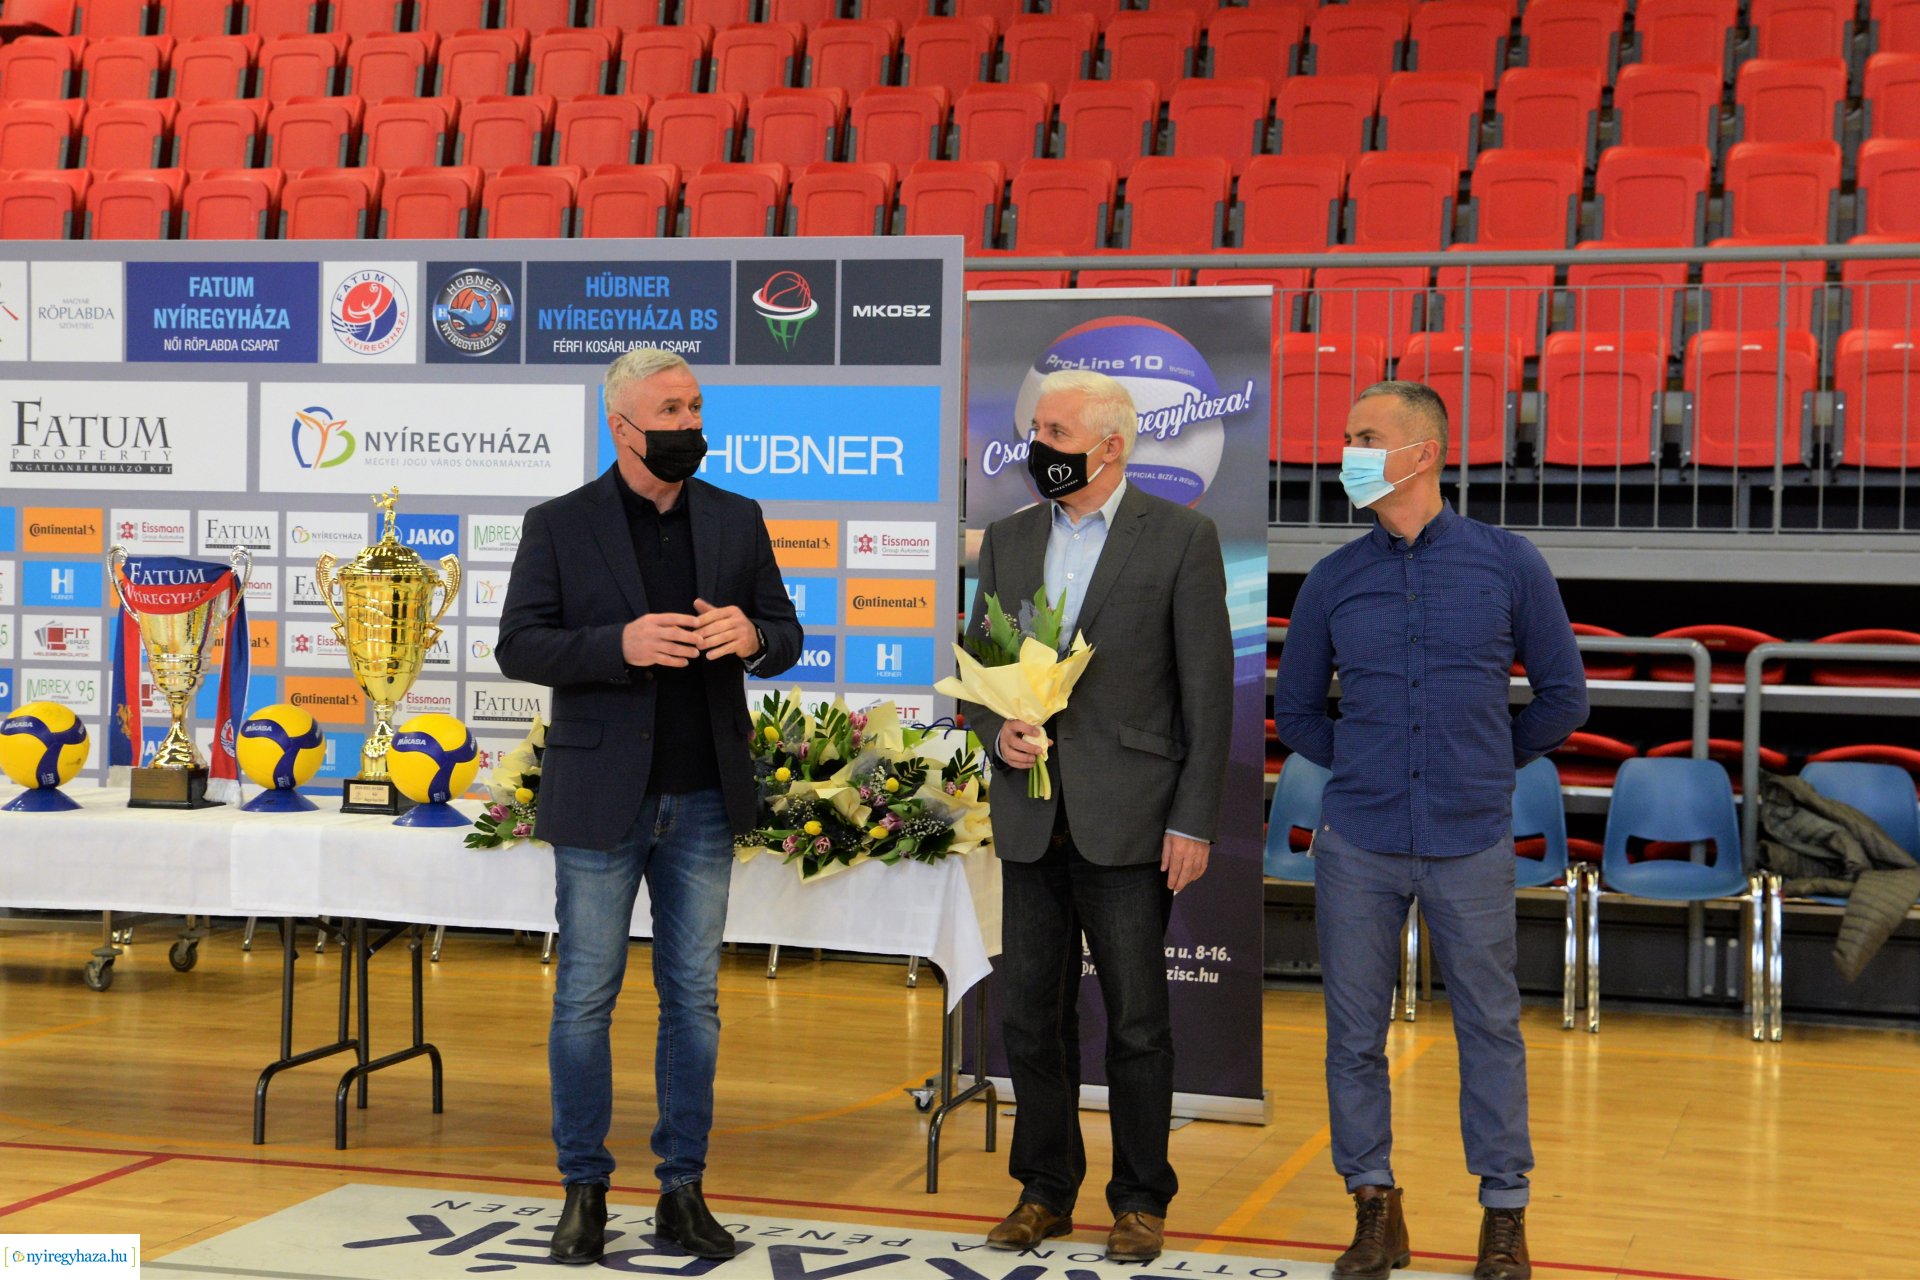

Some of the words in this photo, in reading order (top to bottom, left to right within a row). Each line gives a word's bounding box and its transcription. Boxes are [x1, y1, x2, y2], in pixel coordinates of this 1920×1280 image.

[189, 276, 254, 297] FATUM
[336, 273, 385, 302] FATUM
[586, 272, 670, 298] HÜBNER
[38, 304, 115, 320] RÖPLABDA
[153, 304, 291, 330] NYÍREGYHÁZA
[538, 304, 684, 330] NYÍREGYHÁZA
[690, 308, 718, 330] BS
[852, 304, 931, 317] MKOSZ
[164, 336, 181, 351] NŐI
[184, 336, 238, 352] RÖPLABDA
[241, 339, 279, 352] CSAPAT
[553, 337, 583, 353] FÉRFI
[660, 340, 702, 353] CSAPAT
[1046, 354, 1125, 370] Pro-Line
[1130, 355, 1164, 370] 10
[11, 396, 172, 449] FATUM
[365, 426, 551, 454] NYÍREGYHÁZA
[12, 448, 172, 462] PROPERTY
[365, 457, 399, 466] MEGYEI
[430, 457, 462, 467] VÁROS
[465, 457, 551, 468] ÖNKORMÁNYZATA
[700, 434, 904, 476] HÜBNER
[10, 462, 143, 473] INGATLANBERUHÁZÓ
[150, 464, 172, 474] KFT
[1158, 473, 1174, 481] SIZE
[29, 523, 87, 537] Continental
[142, 521, 184, 533] Eissmann
[205, 519, 270, 540] FATUM
[407, 529, 455, 545] JAKO
[770, 537, 820, 549] ntinental
[882, 534, 929, 546] Eissmann
[130, 561, 206, 585] FATUM
[853, 596, 917, 609] Continental
[64, 628, 90, 639] FIT
[290, 693, 349, 707] Continental
[406, 692, 450, 705] Eissmann
[474, 690, 541, 712] FATUM
[1195, 945, 1231, 961] 8-16.
[951, 1241, 987, 1252] A
